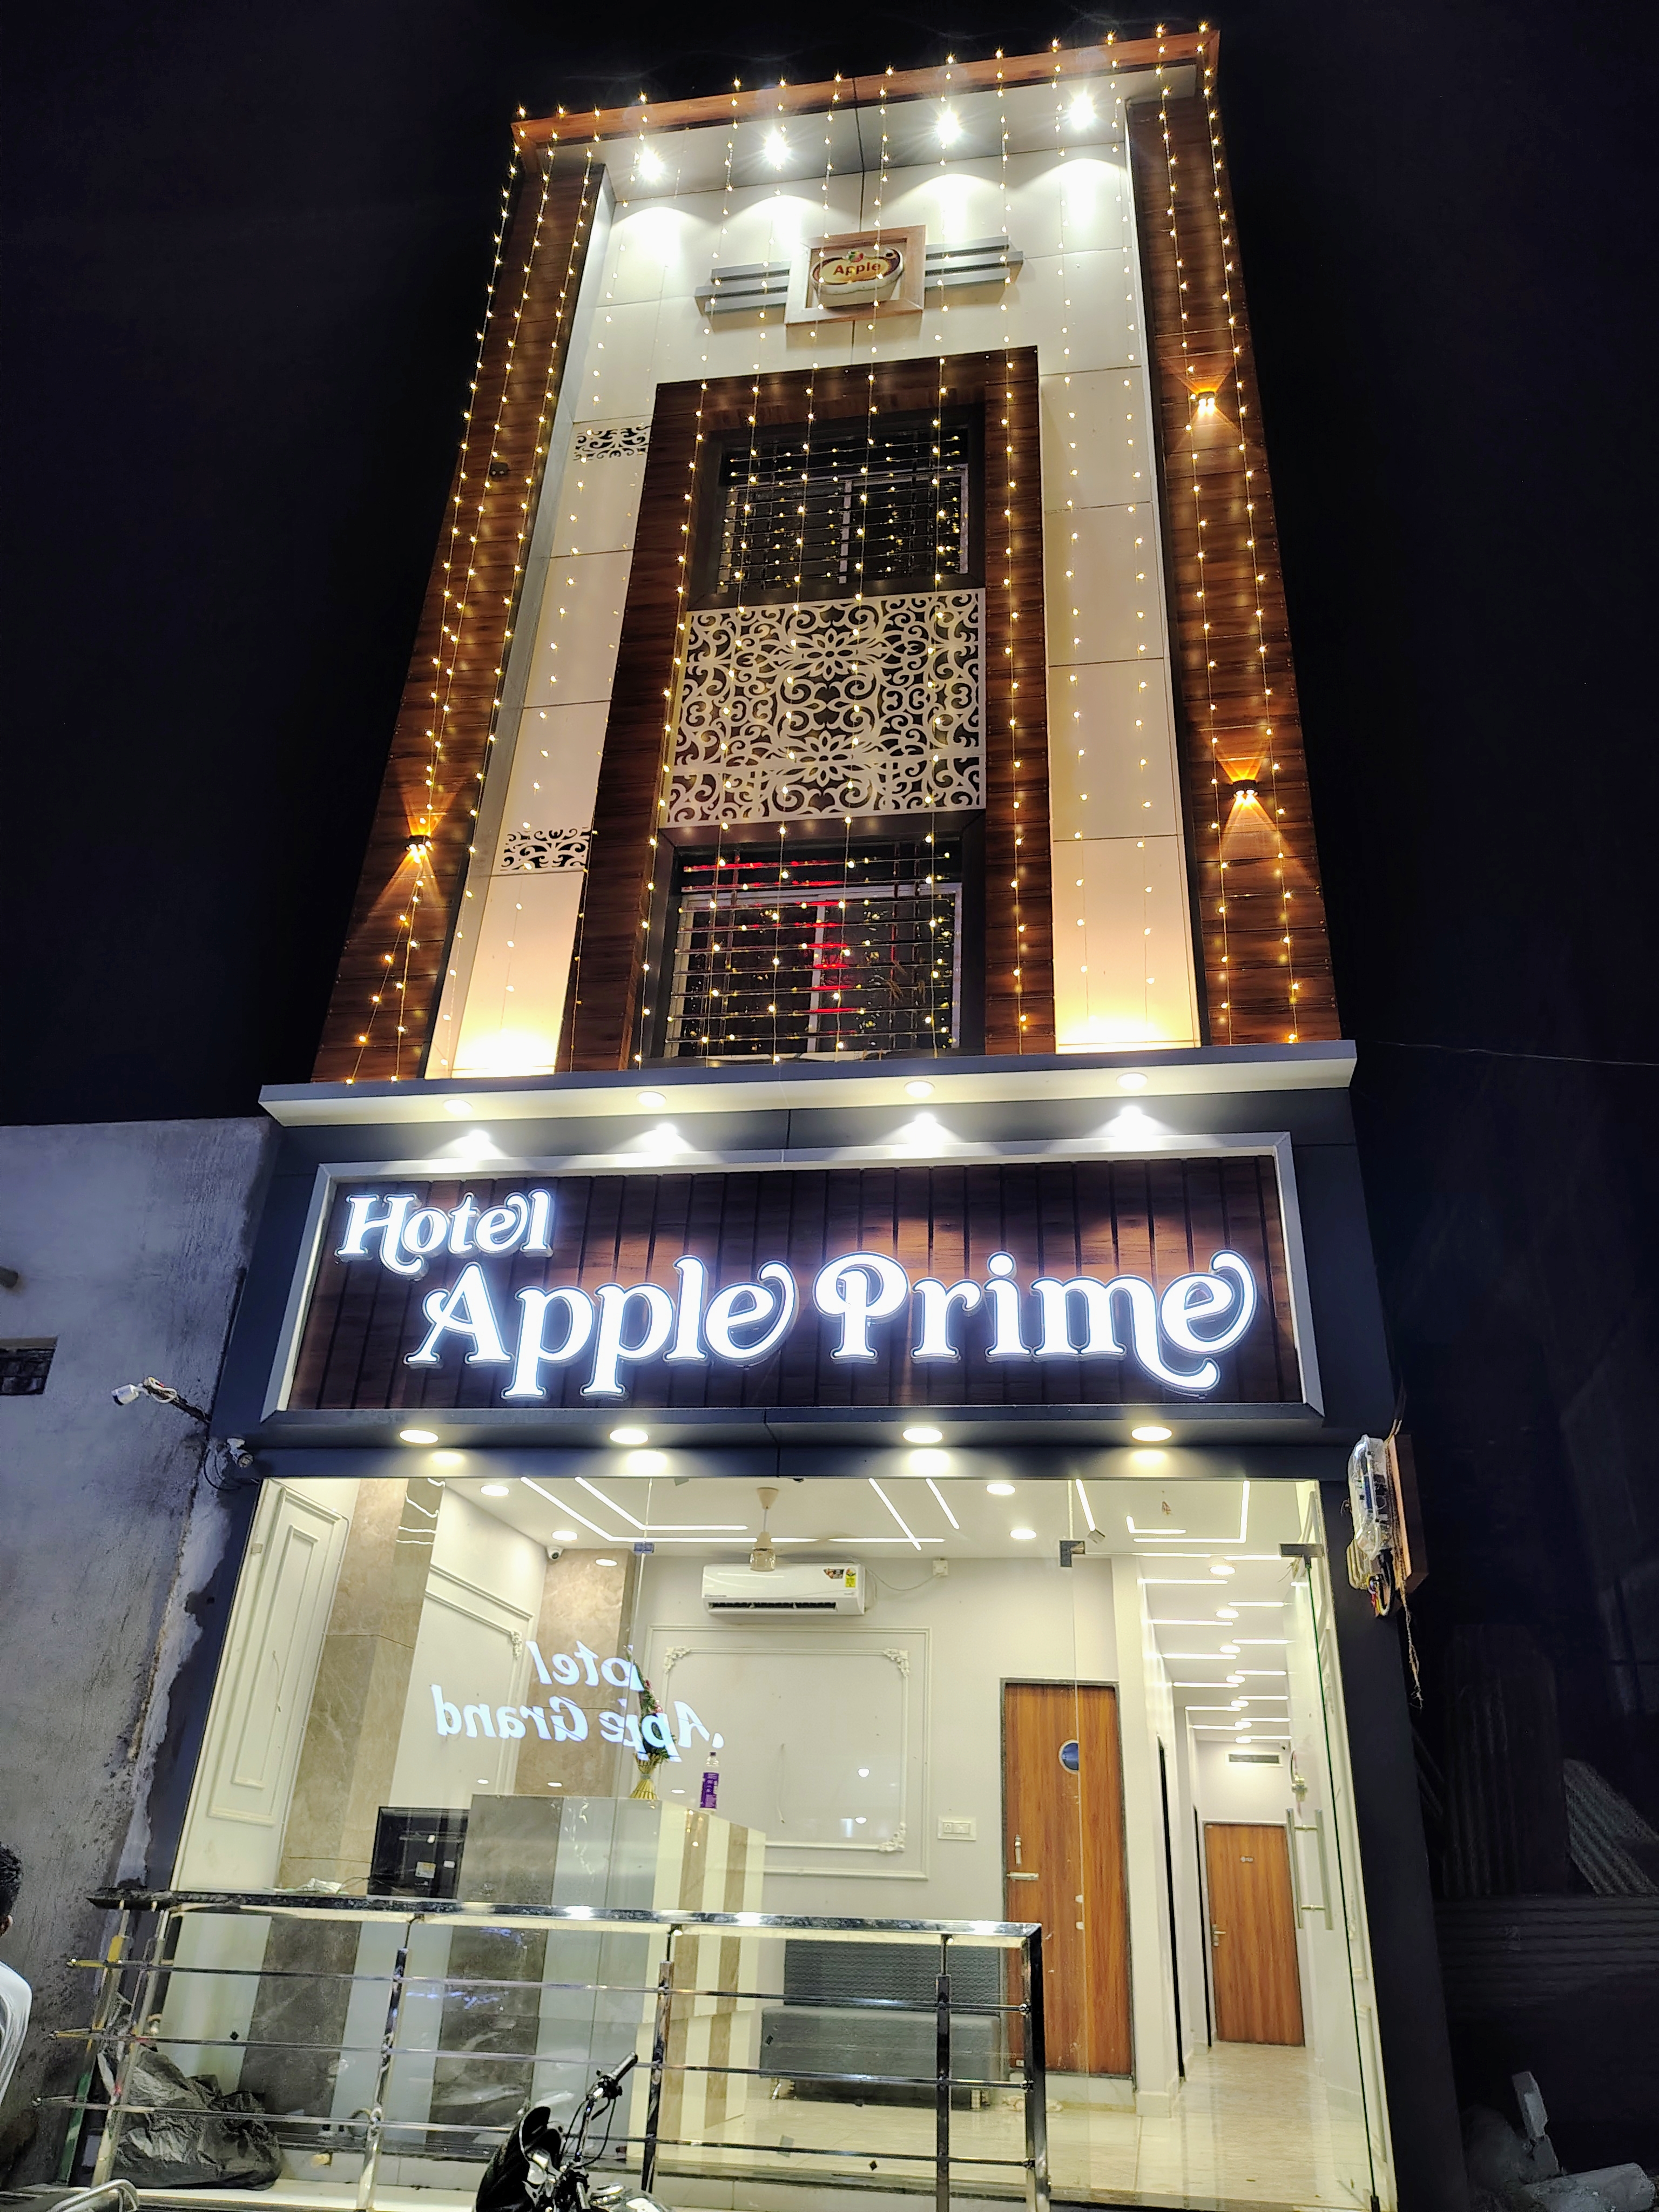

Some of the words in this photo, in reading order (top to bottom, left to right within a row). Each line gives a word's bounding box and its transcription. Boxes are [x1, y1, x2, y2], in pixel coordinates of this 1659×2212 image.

[832, 261, 881, 276] Apple
[335, 1188, 553, 1278] Hotel
[403, 1255, 799, 1400] Apple
[812, 1249, 1258, 1393] Prime
